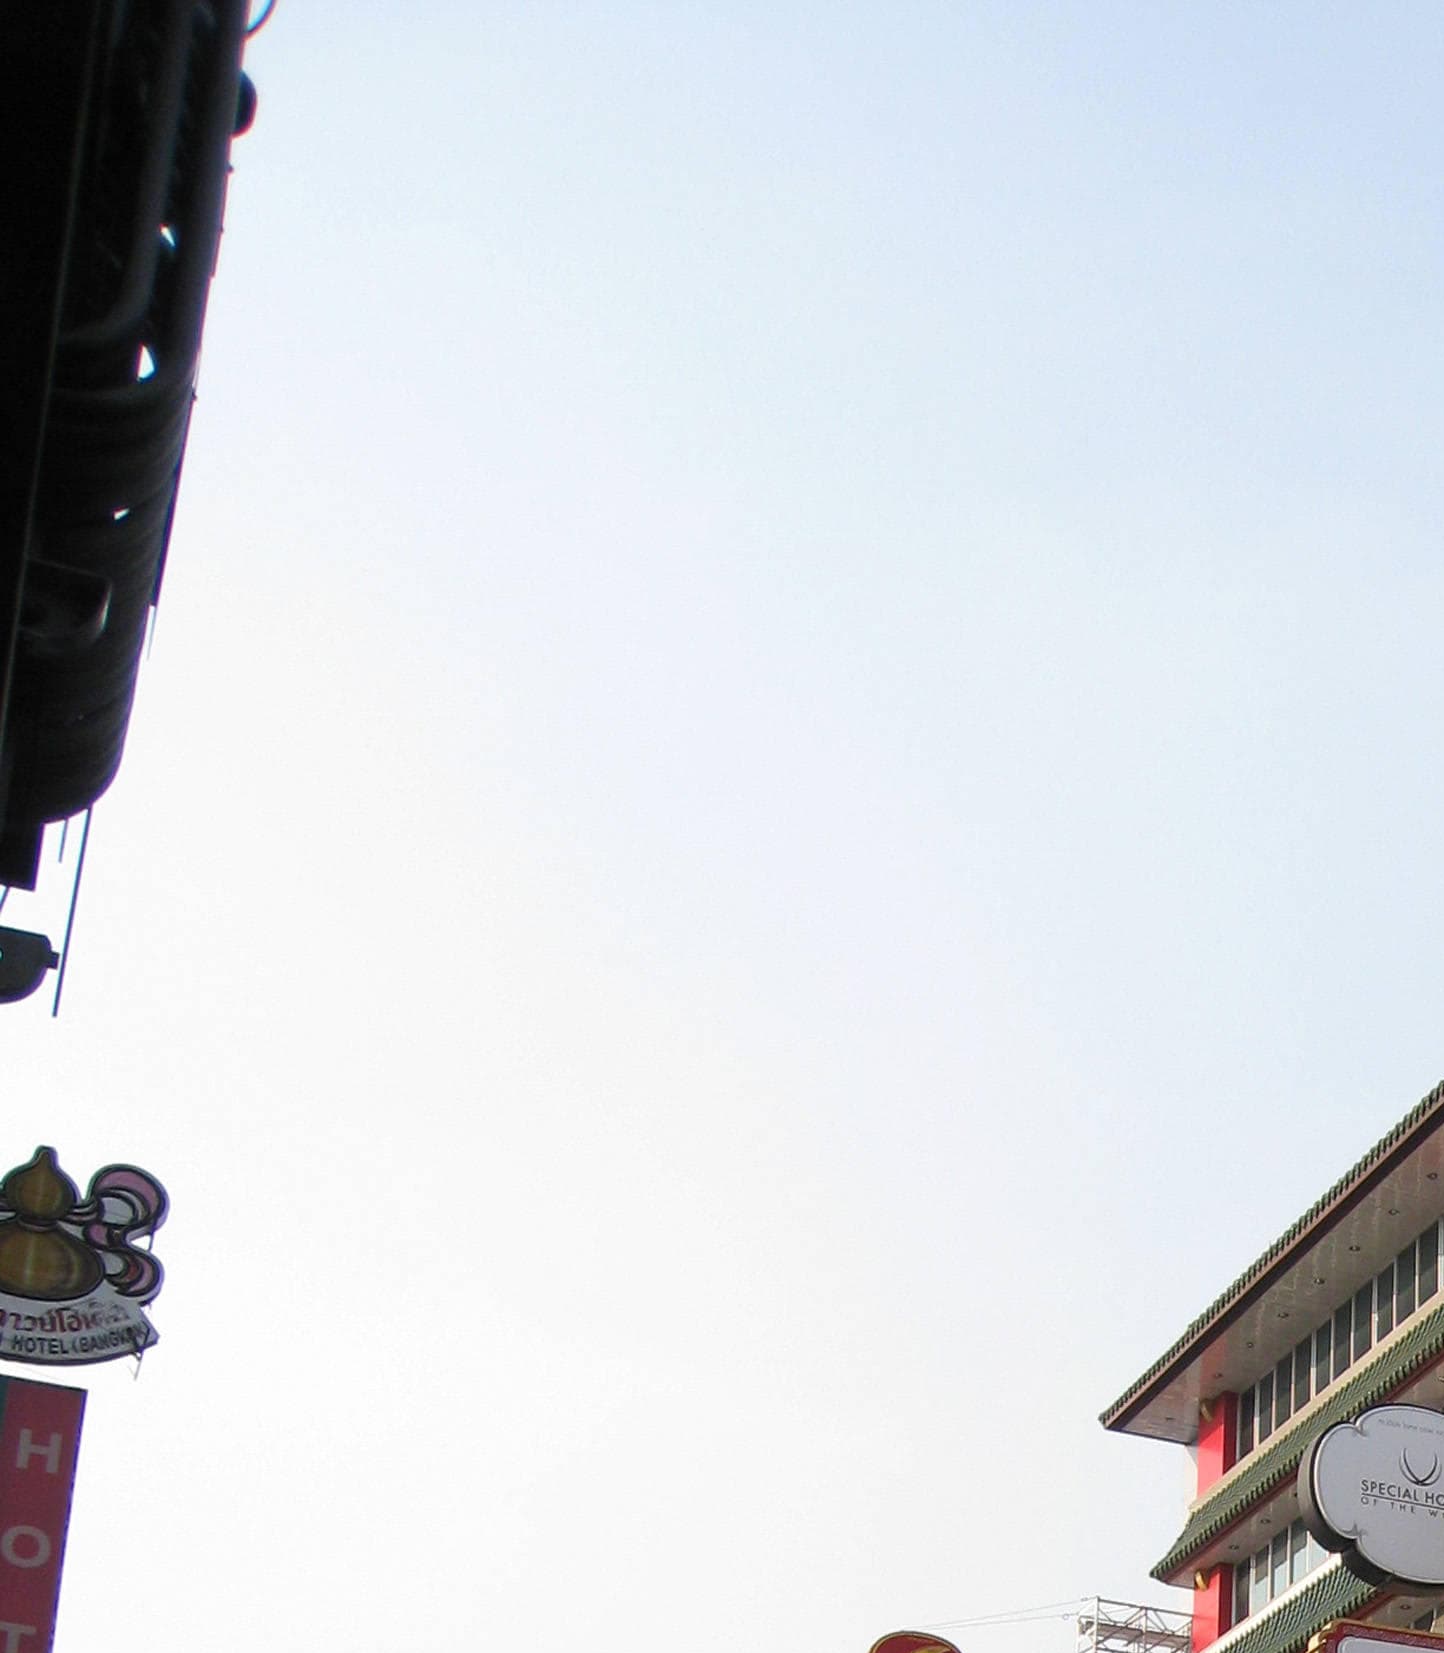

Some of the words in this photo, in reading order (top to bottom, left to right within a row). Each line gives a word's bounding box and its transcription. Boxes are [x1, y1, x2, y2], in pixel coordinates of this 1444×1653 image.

[12, 1335, 69, 1354] HOTEL
[1361, 1479, 1419, 1502] SPECIAL
[1390, 1501, 1416, 1514] THE
